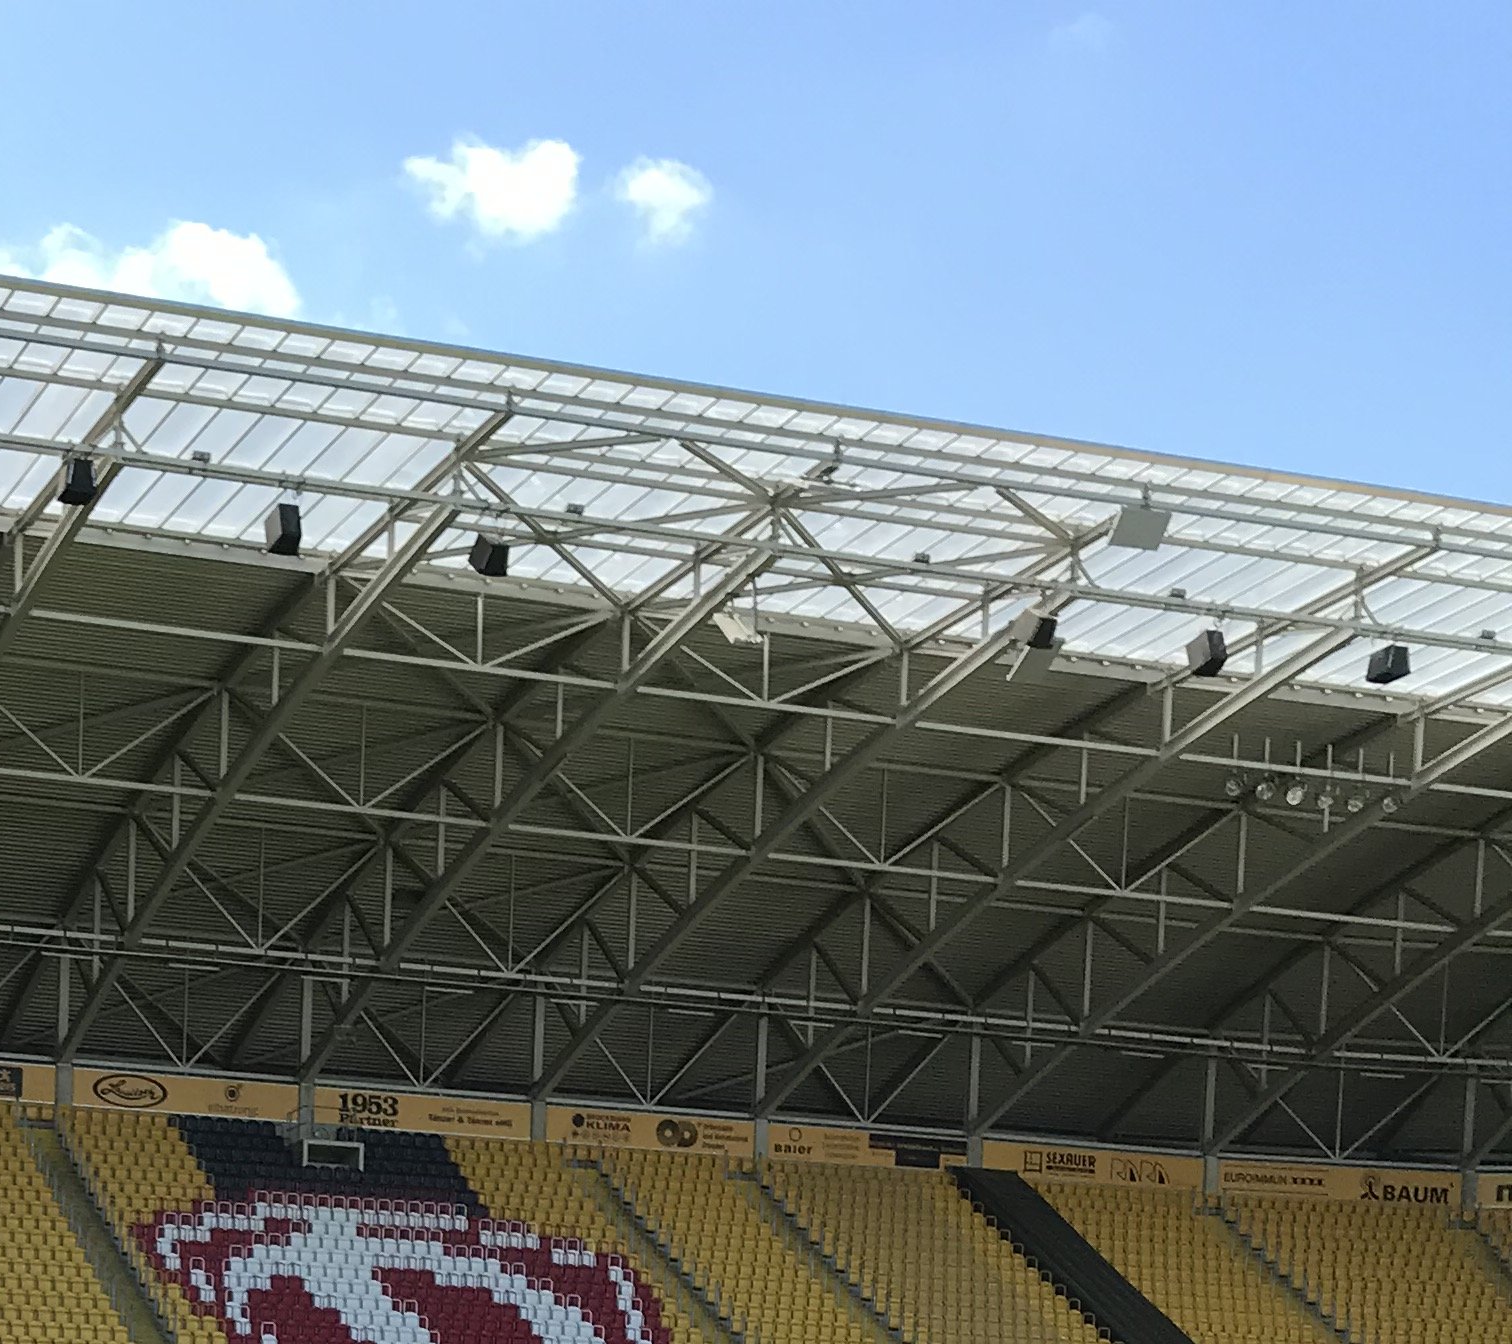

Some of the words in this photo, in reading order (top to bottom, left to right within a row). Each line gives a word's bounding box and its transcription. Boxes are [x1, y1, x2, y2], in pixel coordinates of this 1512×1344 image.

[338, 1092, 399, 1117] 1953
[338, 1112, 399, 1128] Partner
[585, 1121, 632, 1133] KLIMA
[1045, 1151, 1097, 1168] SEXAUER
[1383, 1184, 1449, 1205] BAUM
